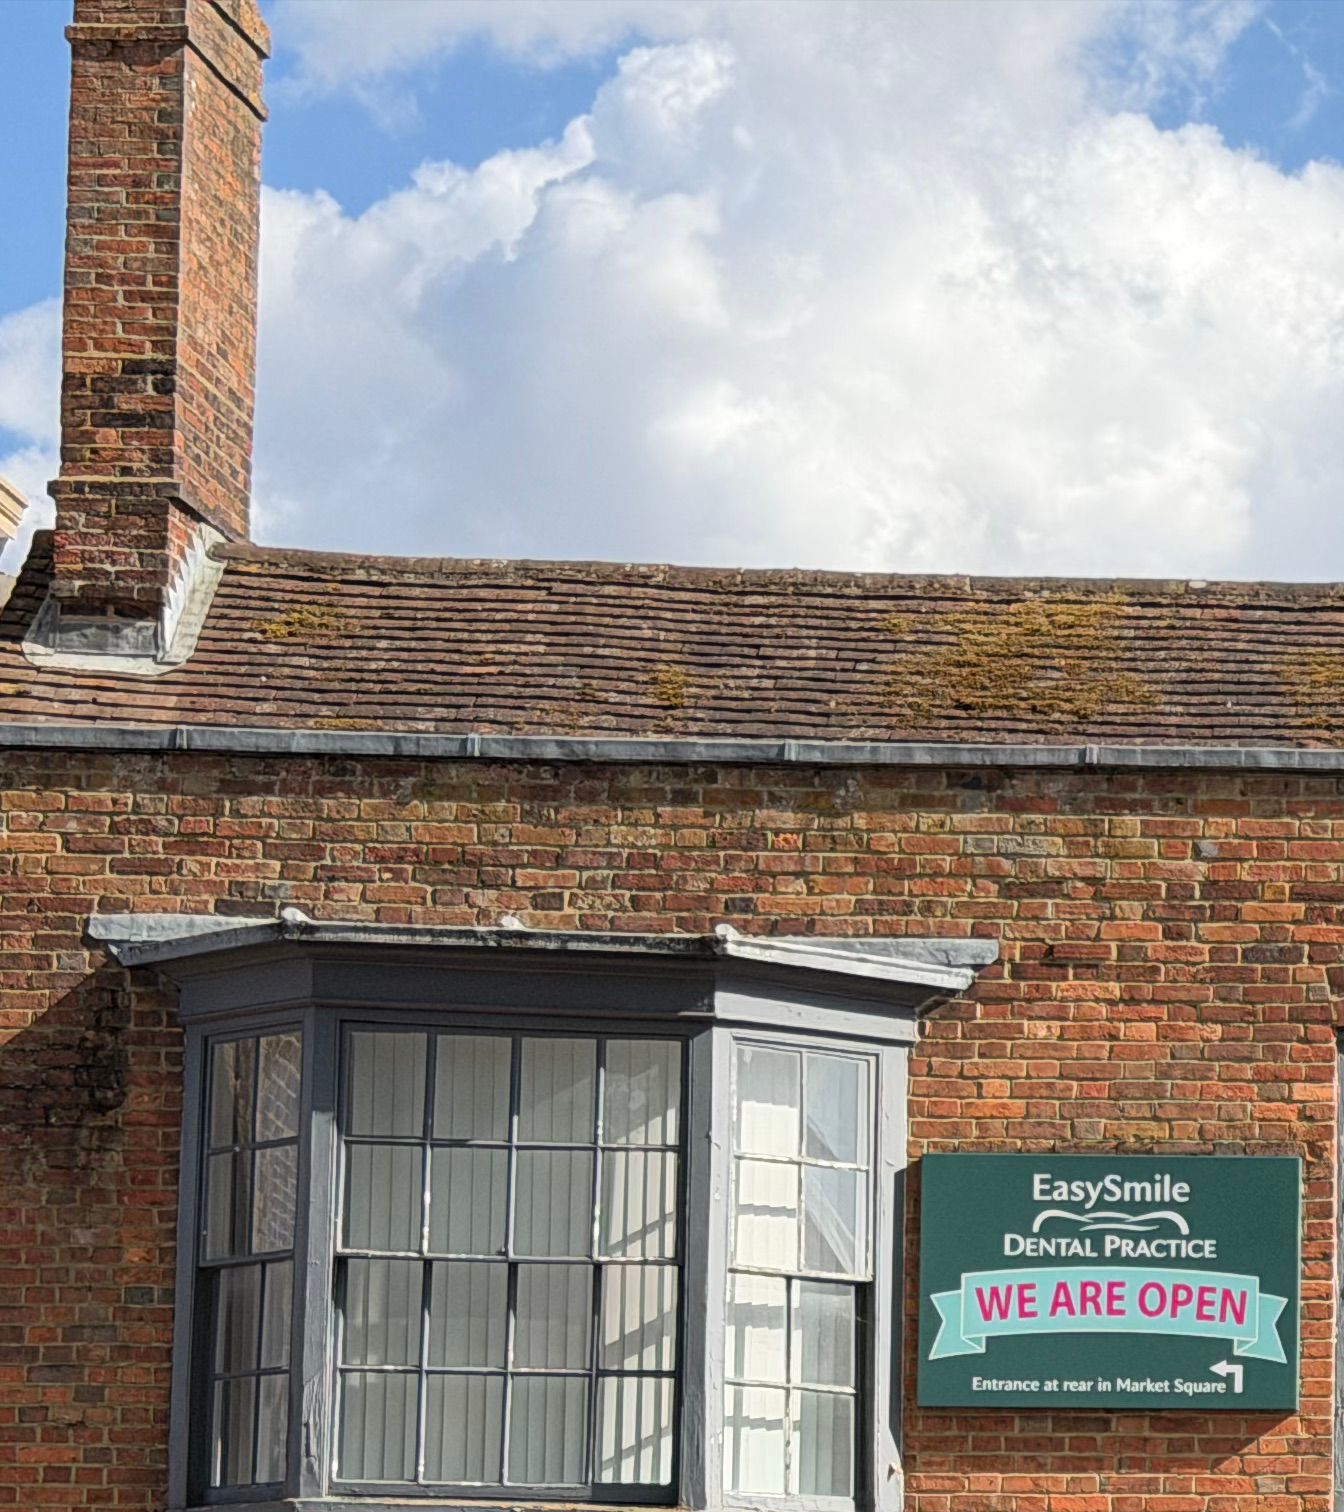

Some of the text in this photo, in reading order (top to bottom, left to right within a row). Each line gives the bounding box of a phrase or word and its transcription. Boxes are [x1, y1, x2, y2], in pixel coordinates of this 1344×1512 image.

[1033, 1173, 1190, 1209] EasySmile
[1004, 1233, 1217, 1259] DENTAL PRACTICE
[975, 1281, 1248, 1325] WE ARE OPEN
[972, 1376, 1227, 1397] Entrance at rear in Market Square
